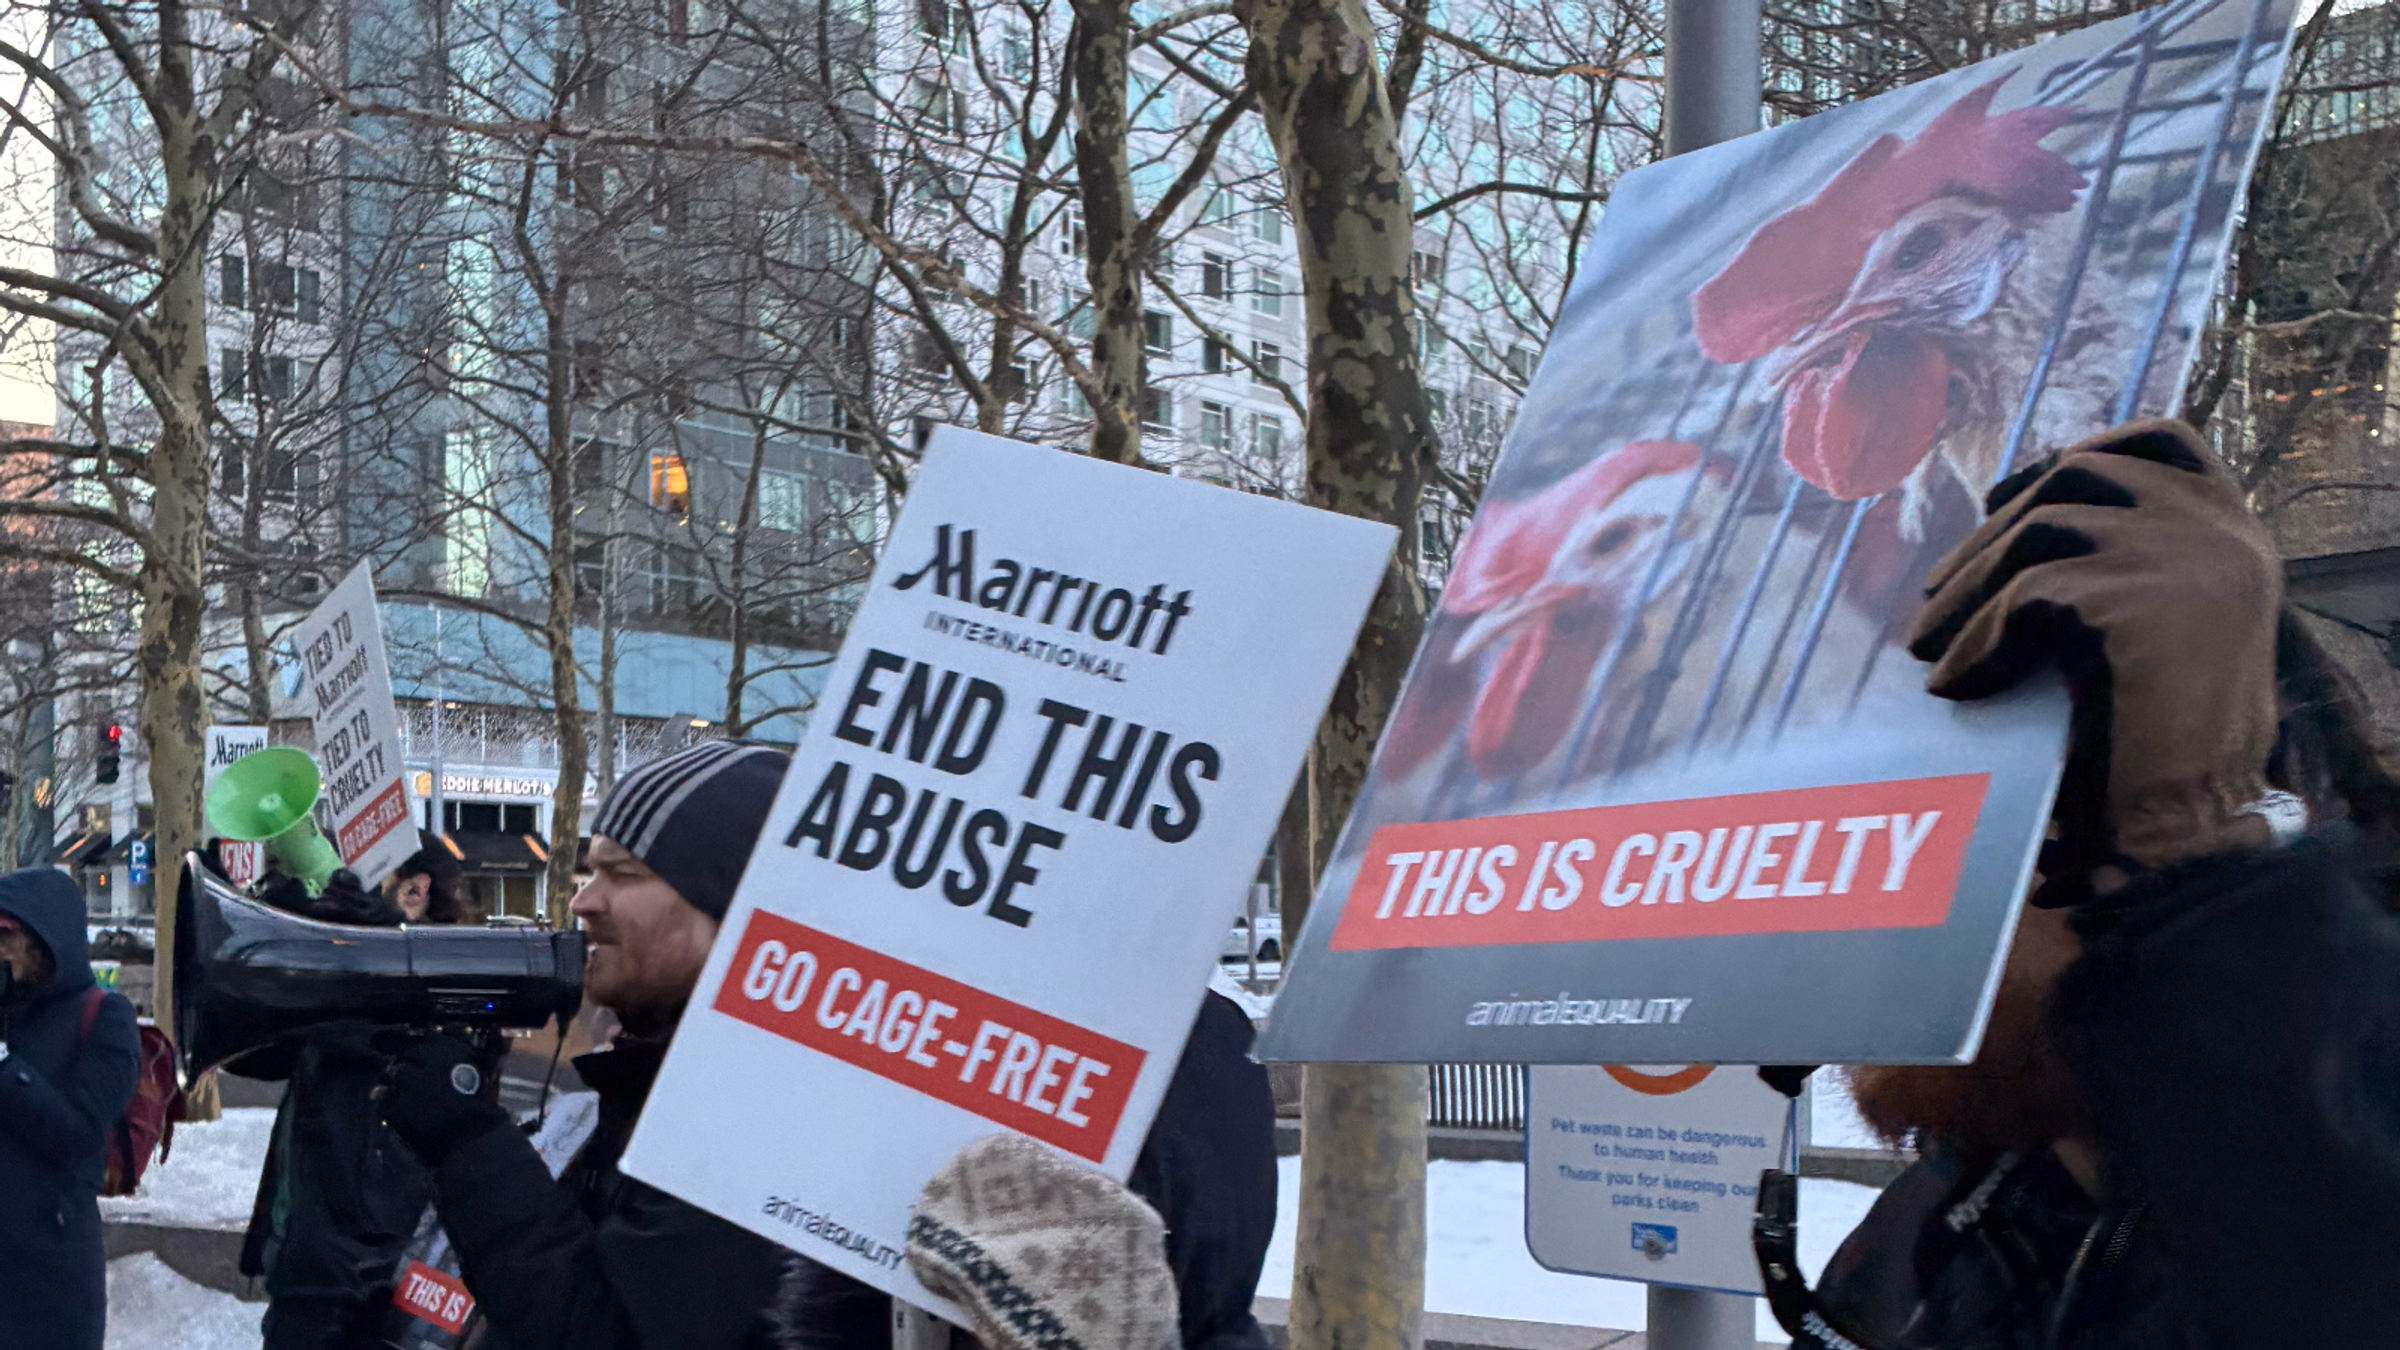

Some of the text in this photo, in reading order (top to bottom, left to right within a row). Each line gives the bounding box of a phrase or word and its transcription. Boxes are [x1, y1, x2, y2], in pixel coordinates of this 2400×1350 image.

[889, 523, 1195, 656] Marriott
[304, 611, 352, 680] TIED TO
[923, 610, 1128, 682] INTERNATIONAL
[322, 709, 371, 776] TIED TO
[835, 647, 1221, 843] END THIS
[329, 742, 385, 816] CRUELTY
[484, 777, 551, 795] MERLOT'S
[783, 761, 1067, 928] ABUSE
[1375, 811, 1943, 920] THIS IS CRUELTY
[742, 939, 1111, 1128] GO CAGE-FREE
[1465, 991, 1693, 1026] animalEQUALITY
[1552, 1118, 1766, 1149] Pet waste can be dangerous
[1594, 1144, 1718, 1166] to human health
[1558, 1165, 1601, 1182] Thank
[1607, 1172, 1634, 1187] you
[1637, 1173, 1659, 1188] for
[1664, 1175, 1727, 1198] keeping
[1612, 1193, 1653, 1210] parks
[405, 1272, 447, 1312] THIS
[441, 1290, 466, 1322] IS
